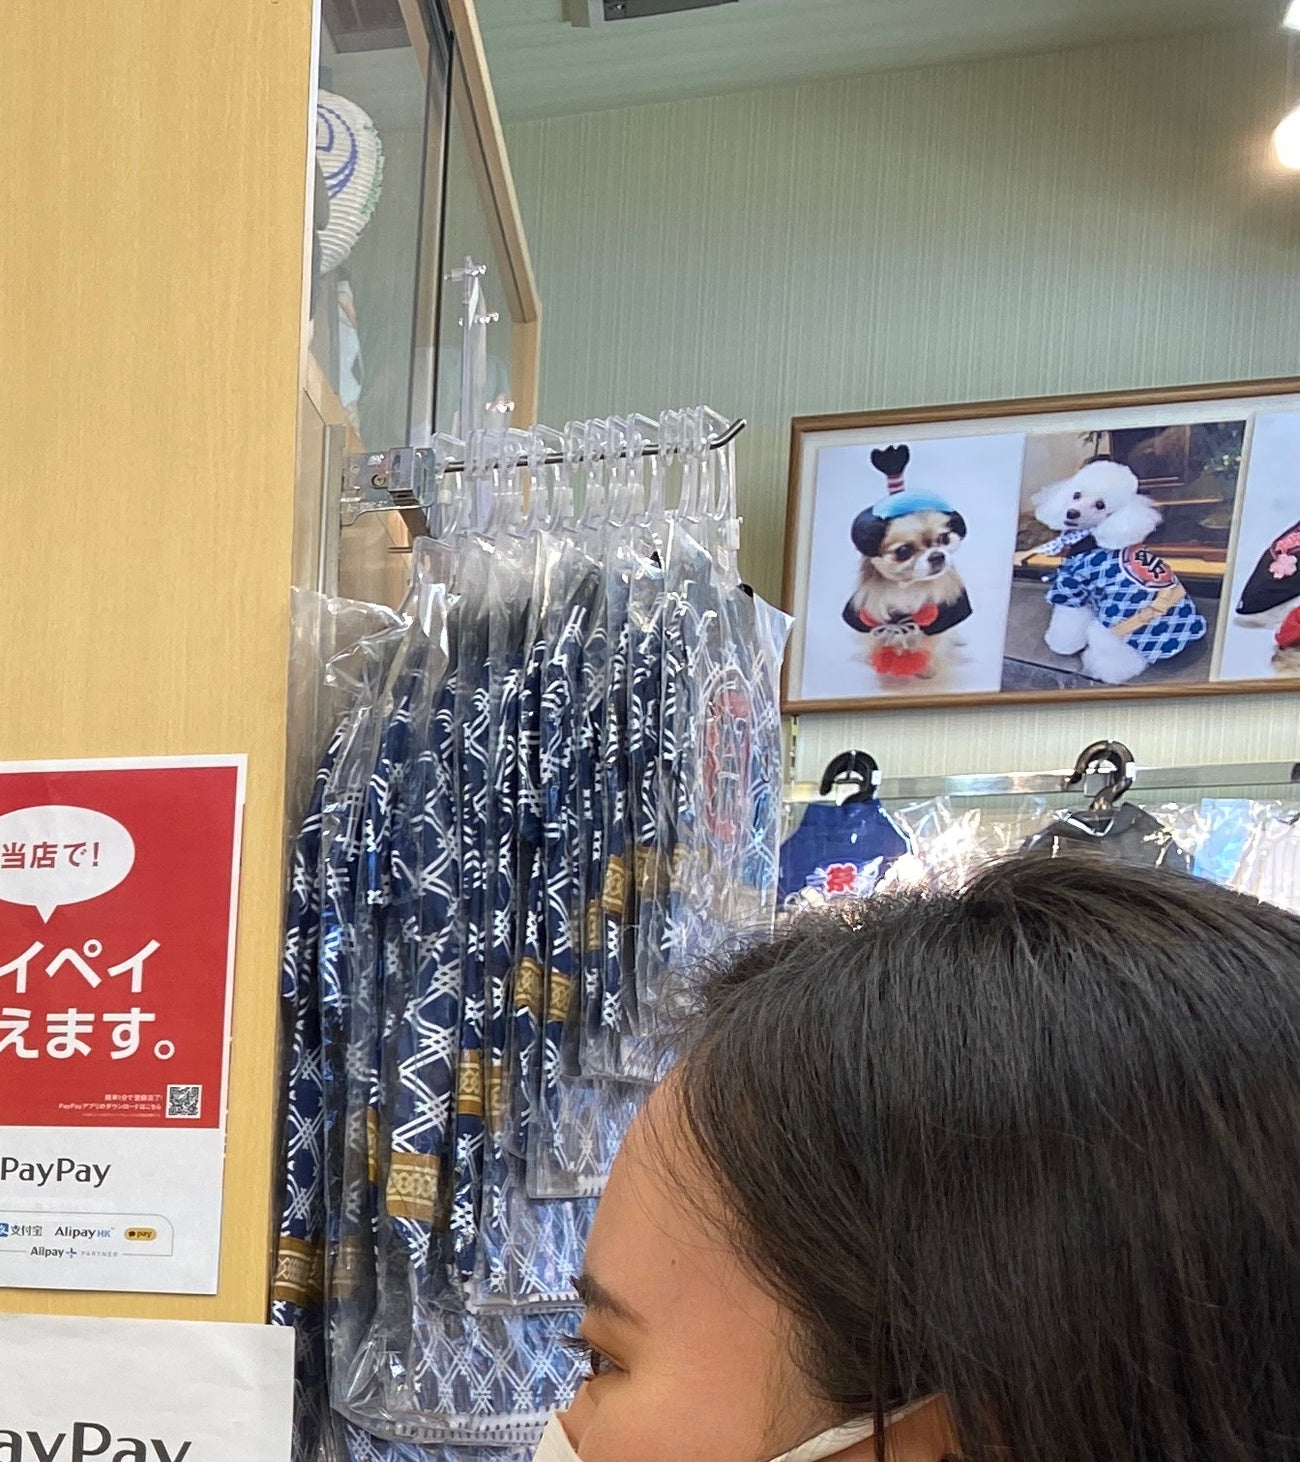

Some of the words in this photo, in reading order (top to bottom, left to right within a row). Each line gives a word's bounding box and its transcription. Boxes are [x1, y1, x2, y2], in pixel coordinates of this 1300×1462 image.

[0, 1155, 112, 1188] PayPay
[10, 1225, 43, 1237] 支付宝
[137, 1230, 153, 1239] pay
